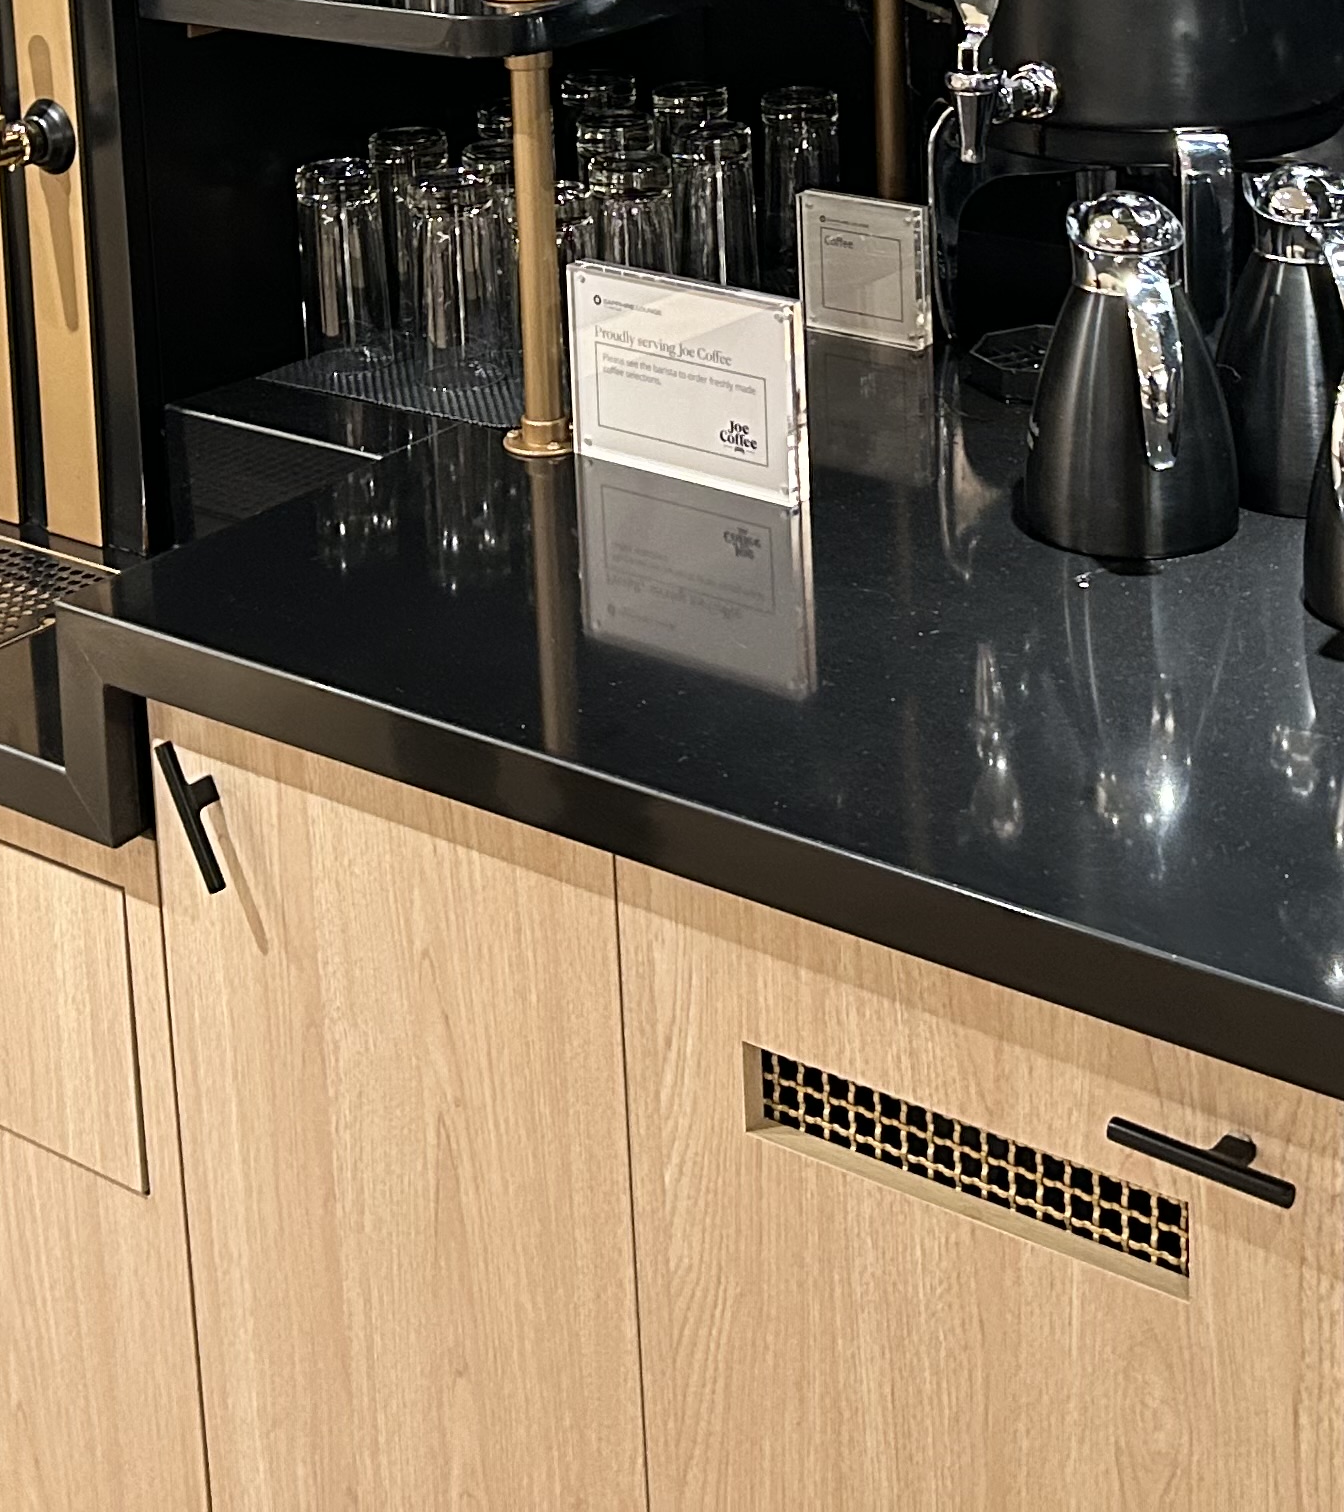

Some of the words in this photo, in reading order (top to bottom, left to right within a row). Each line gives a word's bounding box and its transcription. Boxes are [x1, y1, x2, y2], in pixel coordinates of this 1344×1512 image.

[594, 324, 636, 348] Proudly
[637, 336, 676, 357] serving
[674, 341, 695, 359] Joe
[696, 347, 733, 366] Coffee
[727, 420, 750, 435] Joe
[719, 429, 758, 450] Coffee
